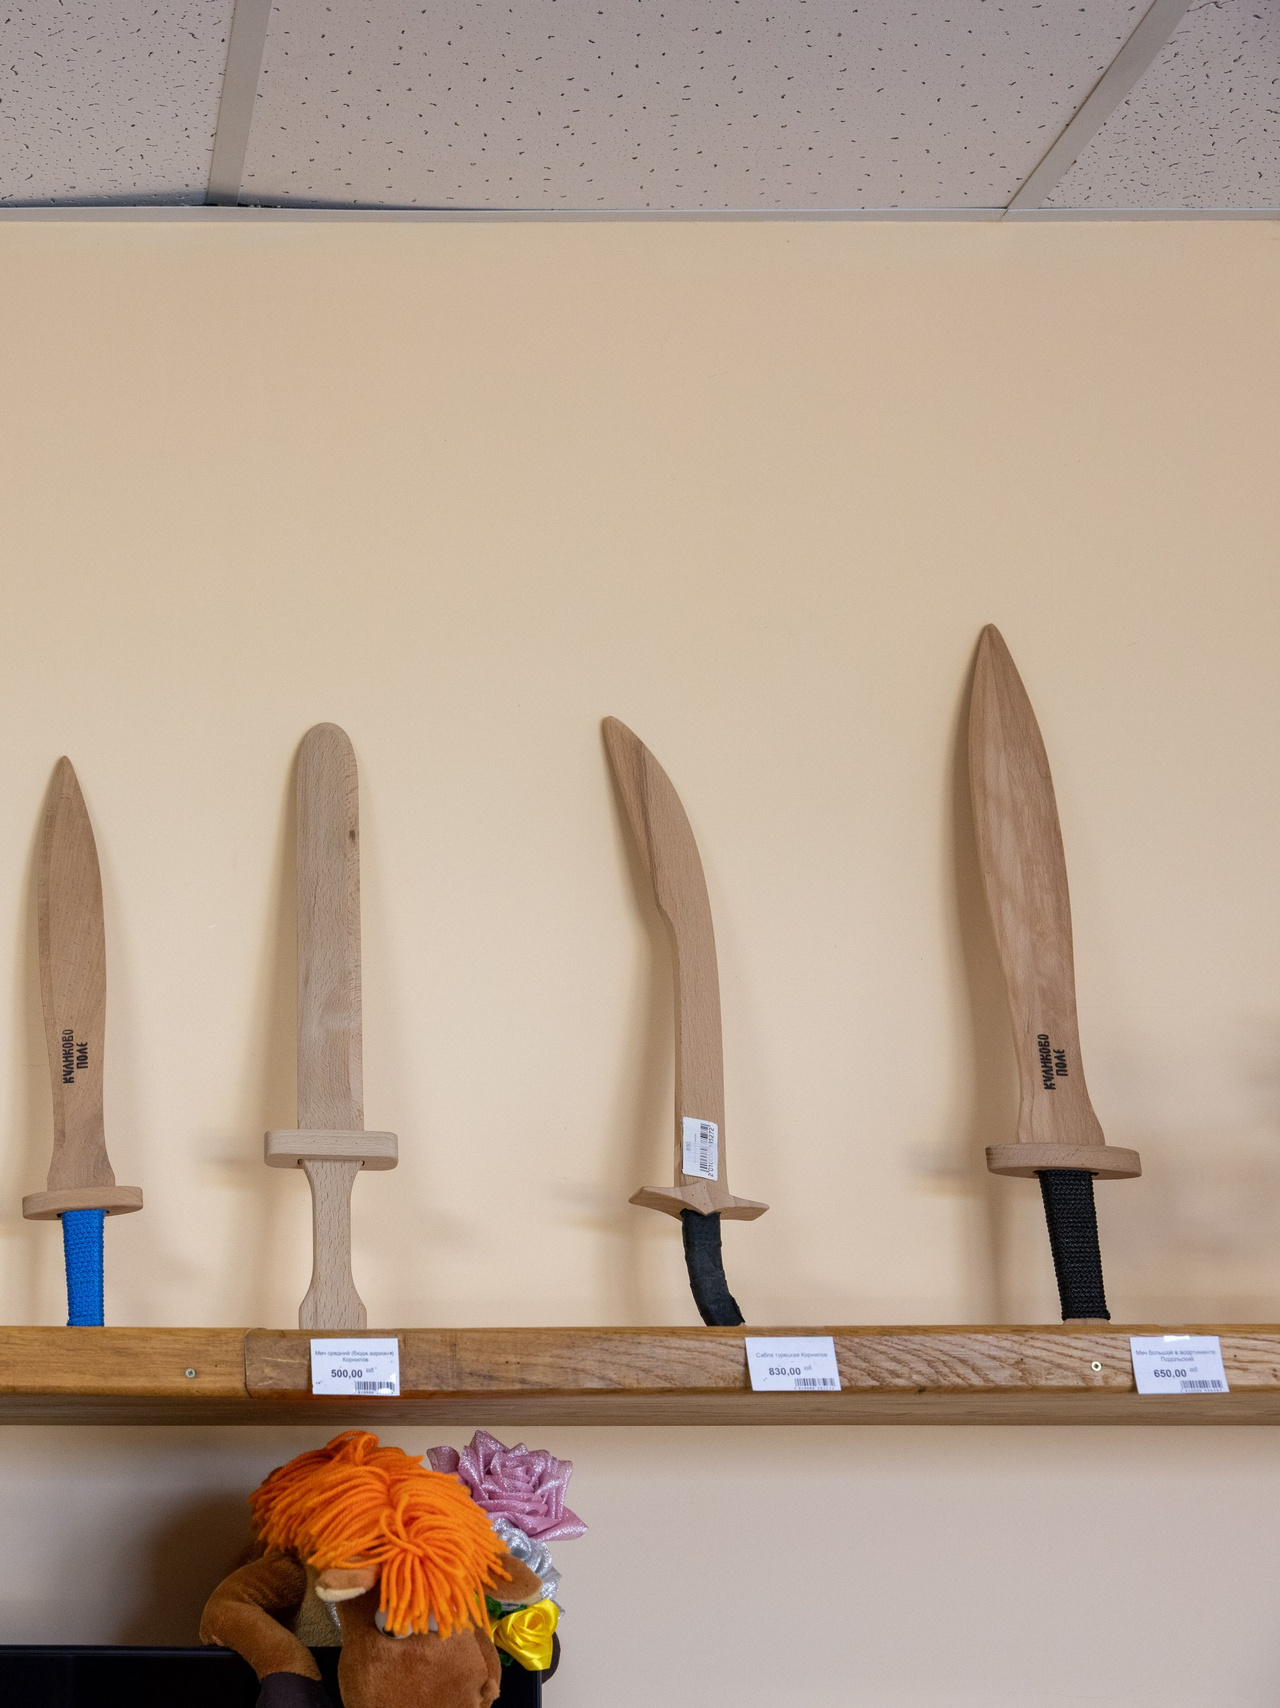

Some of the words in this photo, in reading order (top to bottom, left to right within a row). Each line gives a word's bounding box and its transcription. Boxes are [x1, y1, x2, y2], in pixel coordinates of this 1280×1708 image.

[62, 1029, 74, 1084] КУЛИКОВО
[76, 1042, 88, 1069] ПОЛЕ
[1037, 1034, 1056, 1090] КУЛИКОВО
[1053, 1049, 1068, 1076] ПОЛЕ
[331, 1369, 363, 1379] 500,00
[768, 1367, 801, 1377] 830,00
[1153, 1369, 1187, 1379] 650,00
